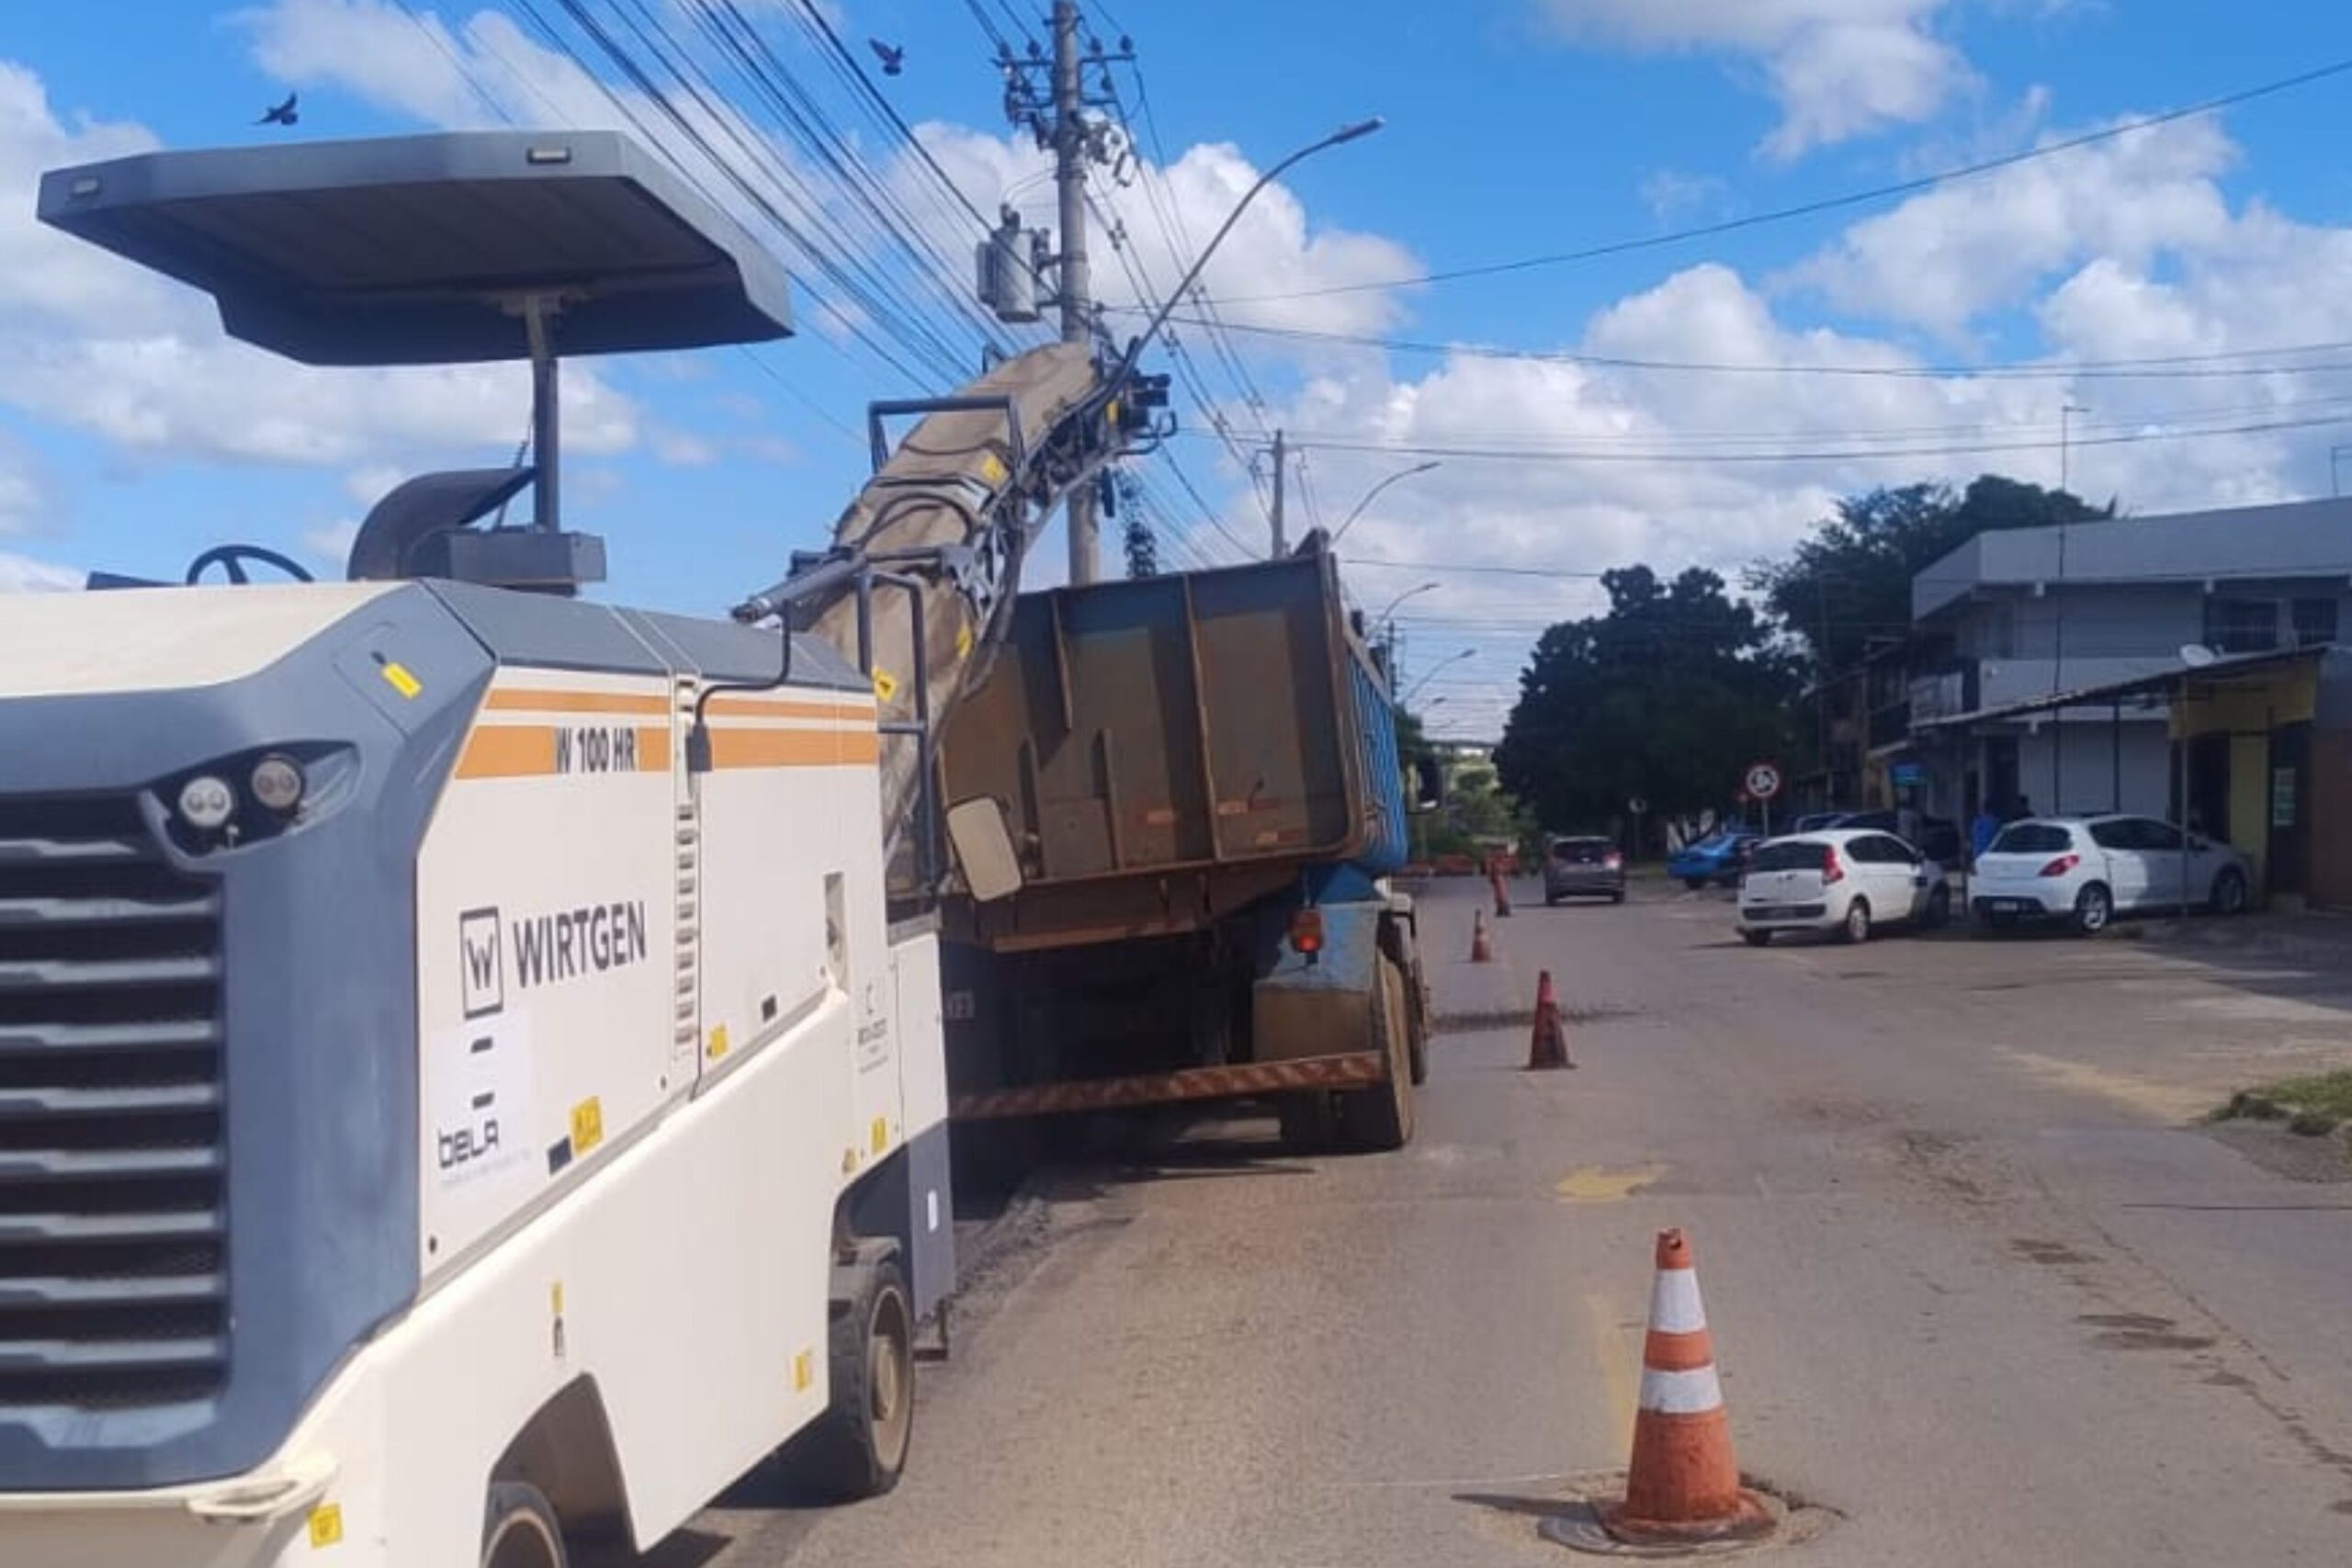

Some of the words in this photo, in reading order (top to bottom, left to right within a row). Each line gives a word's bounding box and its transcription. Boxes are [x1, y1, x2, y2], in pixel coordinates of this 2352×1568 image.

[556, 727, 571, 773] W
[577, 727, 609, 773] 100
[614, 727, 637, 773] HR
[513, 900, 646, 988] WIRTGEN
